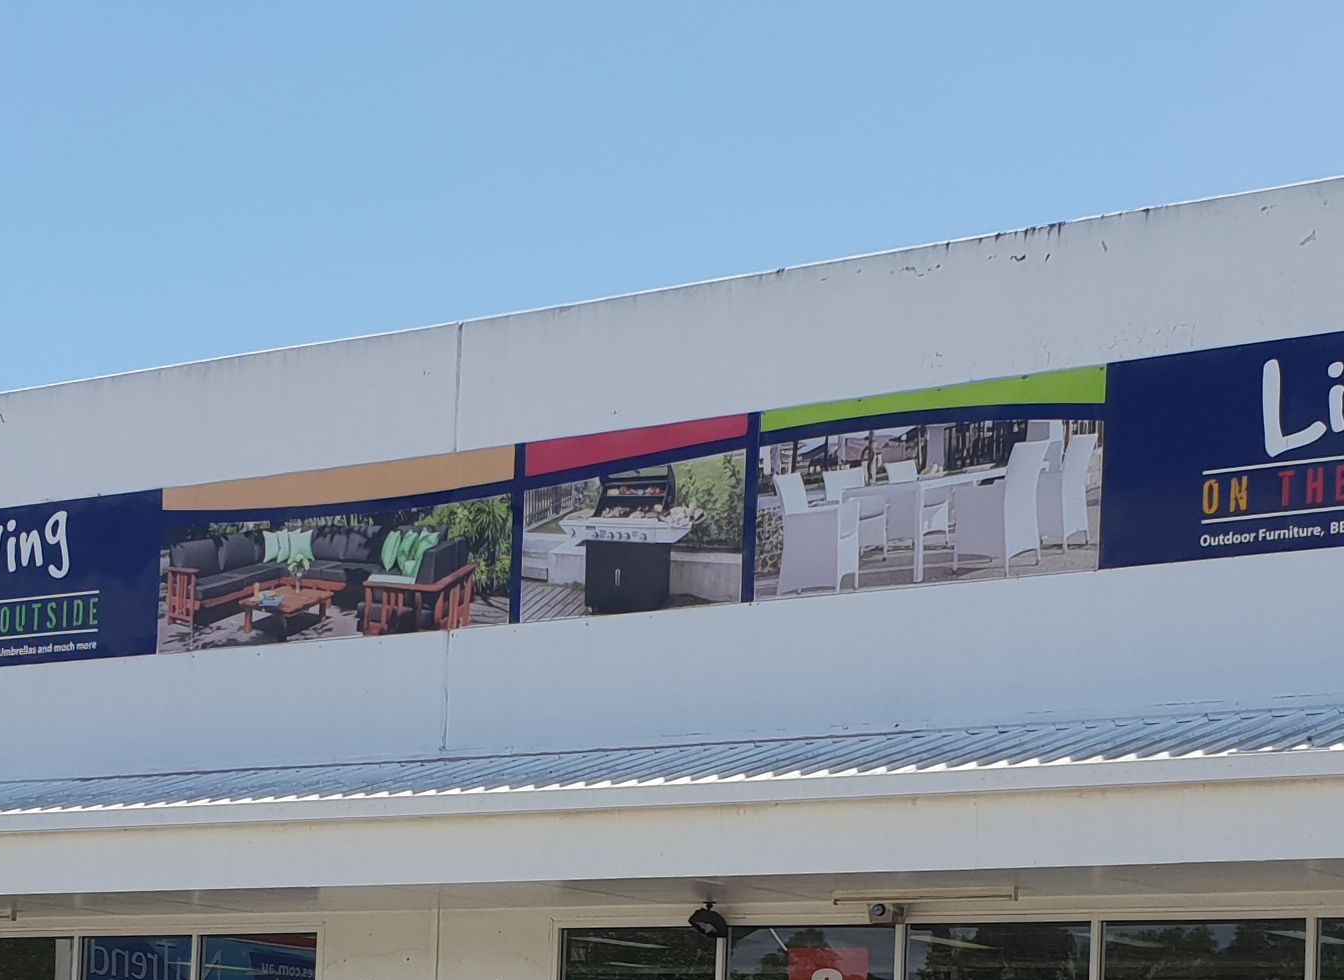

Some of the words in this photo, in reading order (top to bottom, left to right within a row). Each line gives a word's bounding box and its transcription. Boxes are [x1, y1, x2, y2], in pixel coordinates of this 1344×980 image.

[1201, 475, 1249, 515] ON
[1199, 530, 1256, 548] Outdoor
[1258, 522, 1325, 543] Furniture,
[0, 597, 100, 634] OUTSIDE
[37, 643, 52, 654] and
[54, 640, 75, 652] much
[76, 640, 98, 651] more
